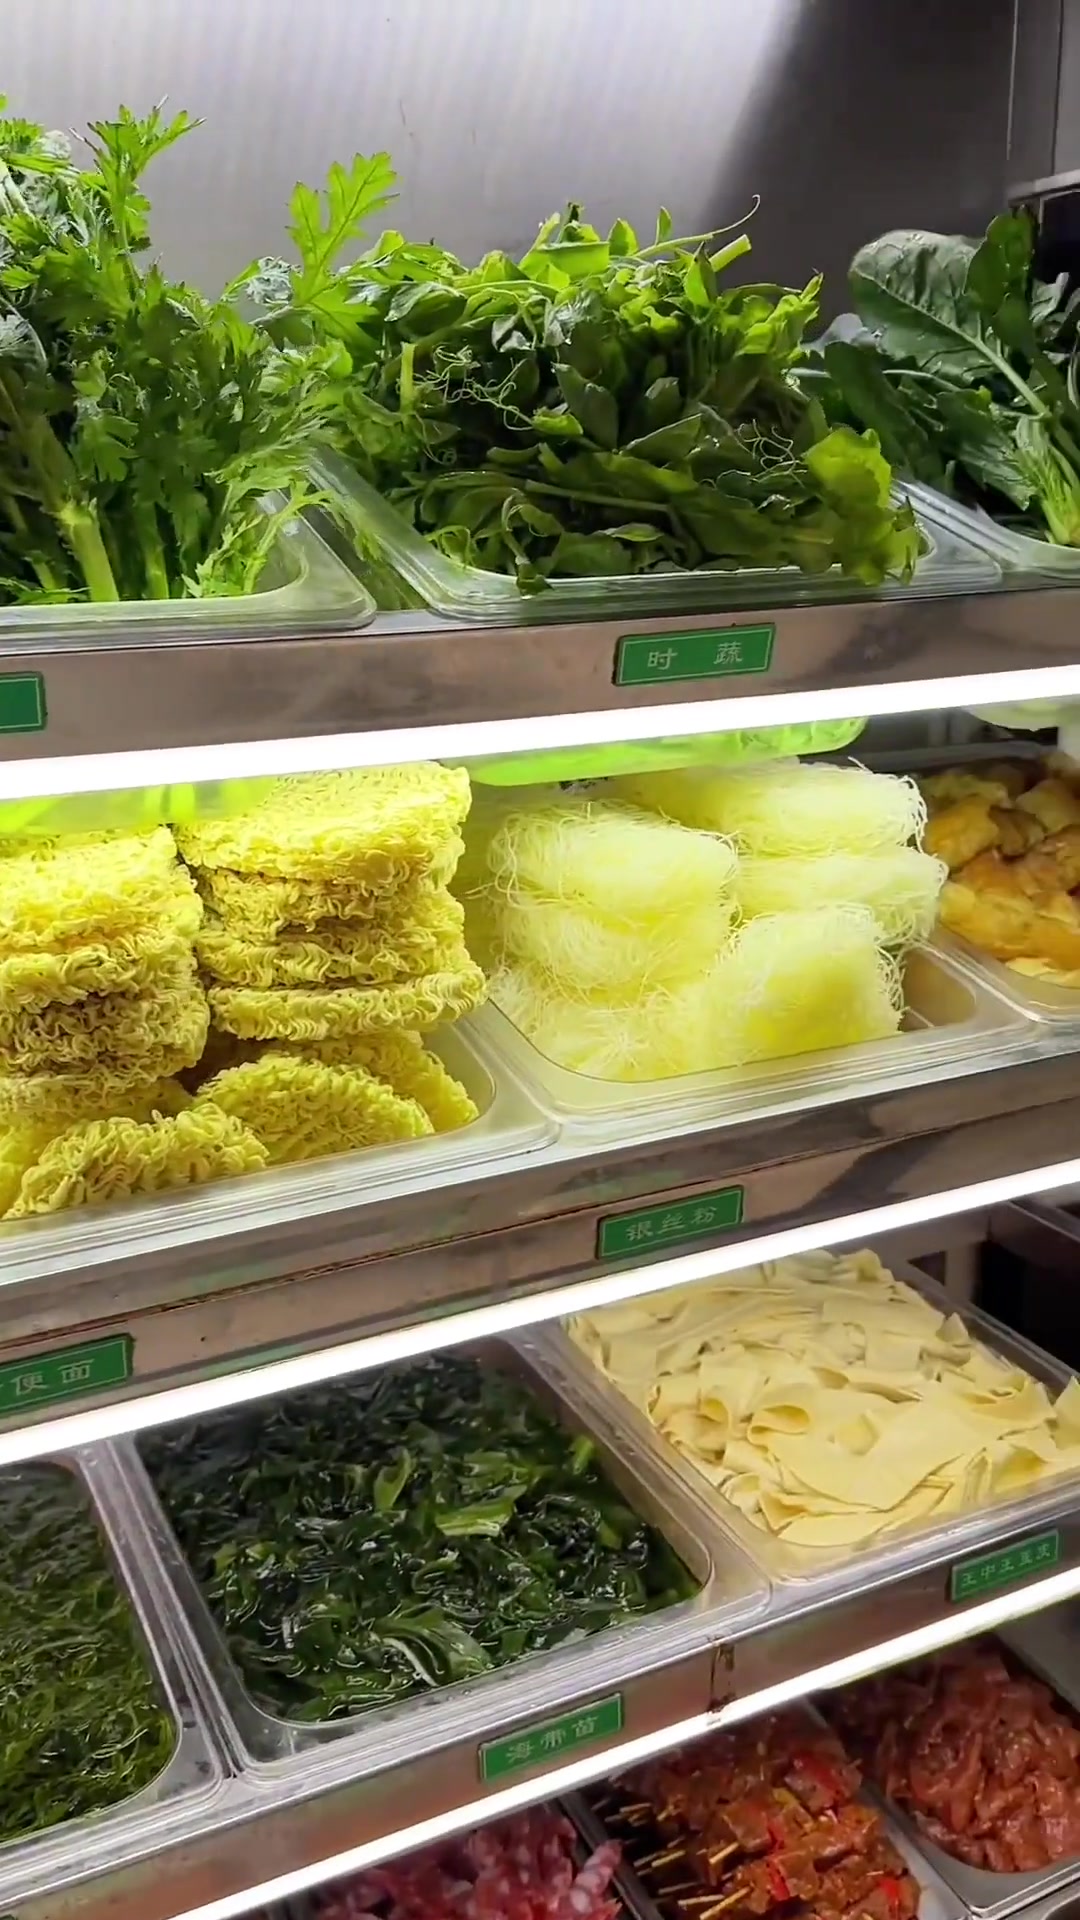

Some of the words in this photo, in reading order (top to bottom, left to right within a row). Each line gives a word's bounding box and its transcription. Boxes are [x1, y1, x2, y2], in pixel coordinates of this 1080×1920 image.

[626, 1206, 718, 1242] 银丝粉
[0, 1358, 95, 1397] 便面
[505, 1715, 599, 1764] 海带苗
